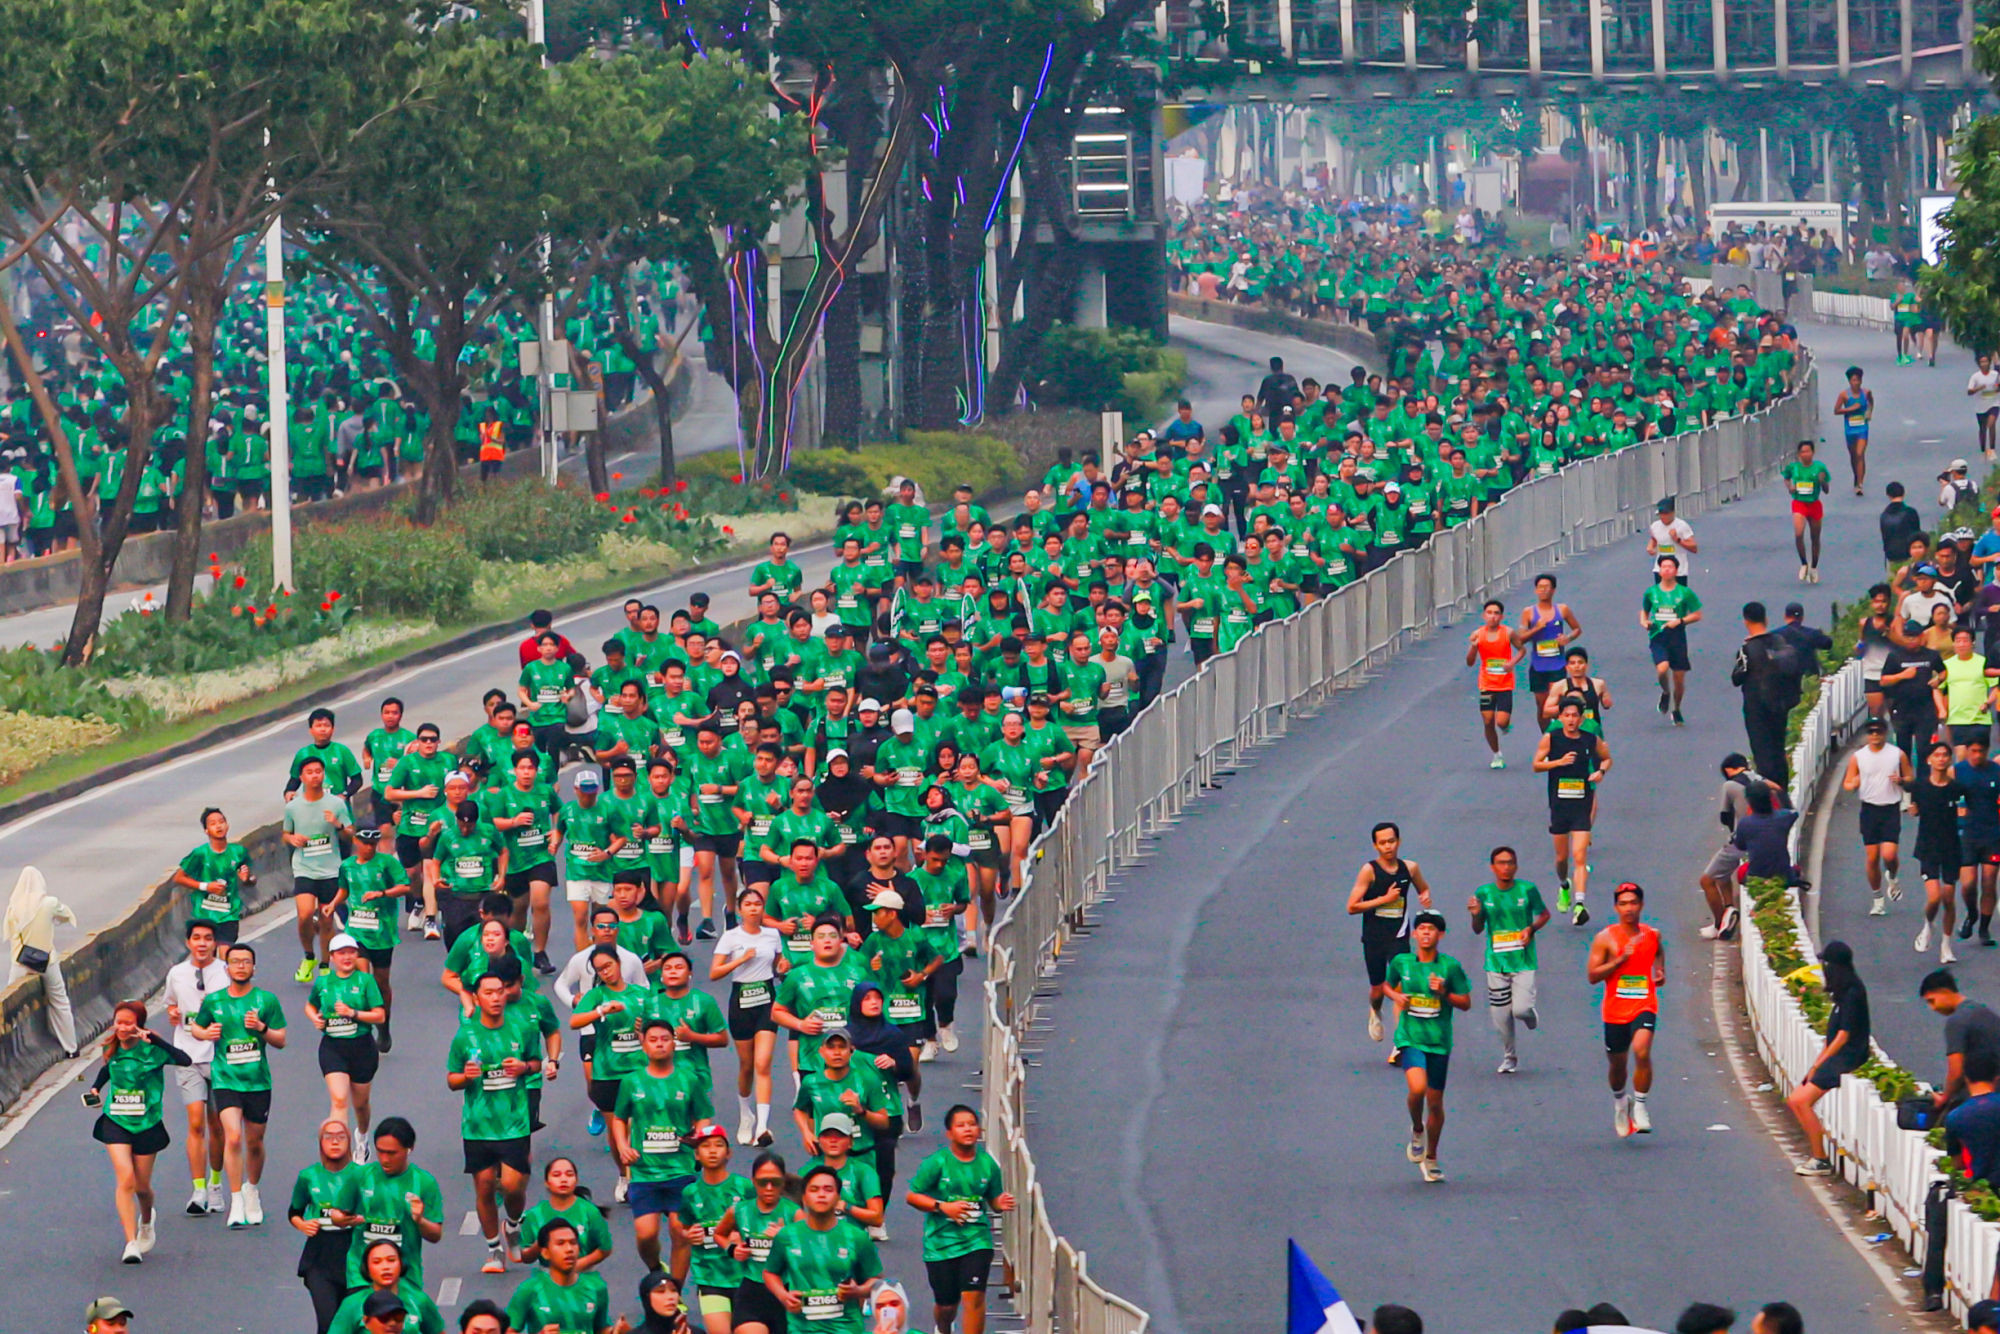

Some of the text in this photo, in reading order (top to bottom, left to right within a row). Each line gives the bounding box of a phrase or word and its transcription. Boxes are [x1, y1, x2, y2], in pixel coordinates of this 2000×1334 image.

[822, 1012, 842, 1020] 2174
[230, 1043, 254, 1053] 51247
[114, 1095, 141, 1104] 76398
[646, 1131, 675, 1141] 70985
[370, 1223, 396, 1234] 51127
[807, 1296, 838, 1306] 52166
